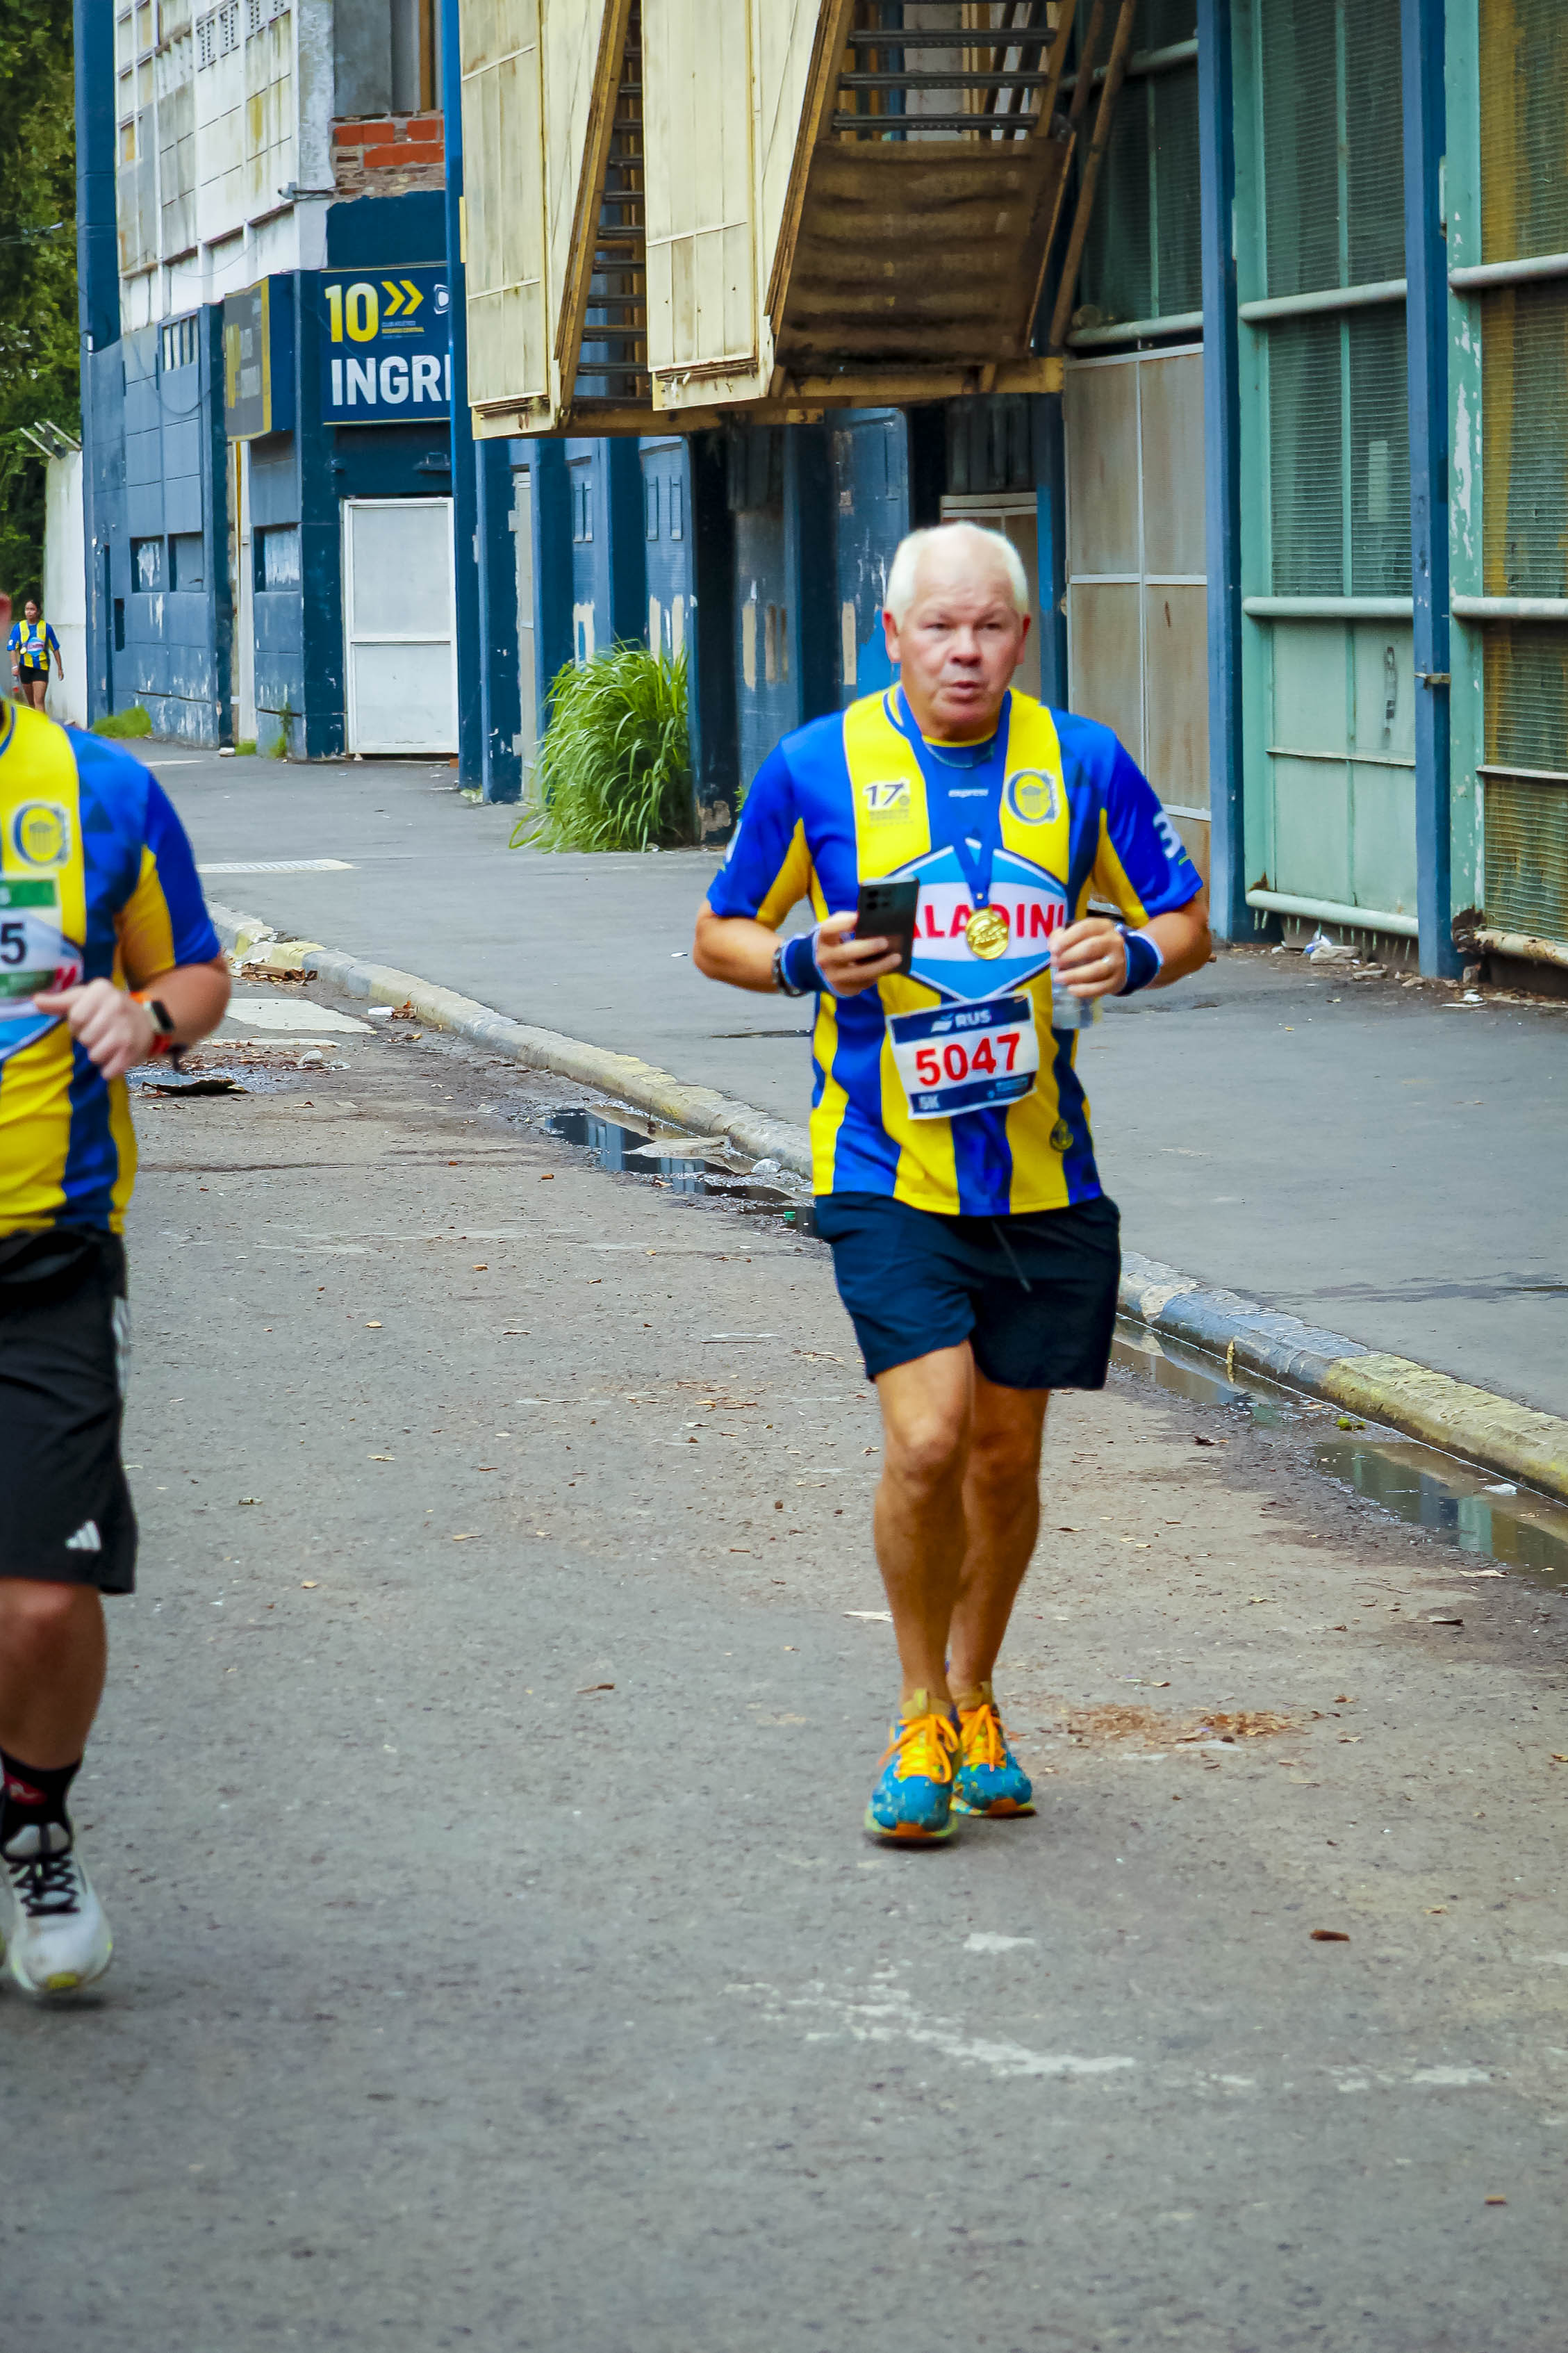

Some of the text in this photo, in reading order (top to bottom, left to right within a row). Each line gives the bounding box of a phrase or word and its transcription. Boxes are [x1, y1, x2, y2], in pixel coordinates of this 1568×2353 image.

[324, 283, 379, 342] 10
[331, 354, 450, 406] INGR
[913, 903, 1064, 938] LADINI
[955, 1009, 991, 1028] RUS
[915, 1033, 1021, 1086] 5047
